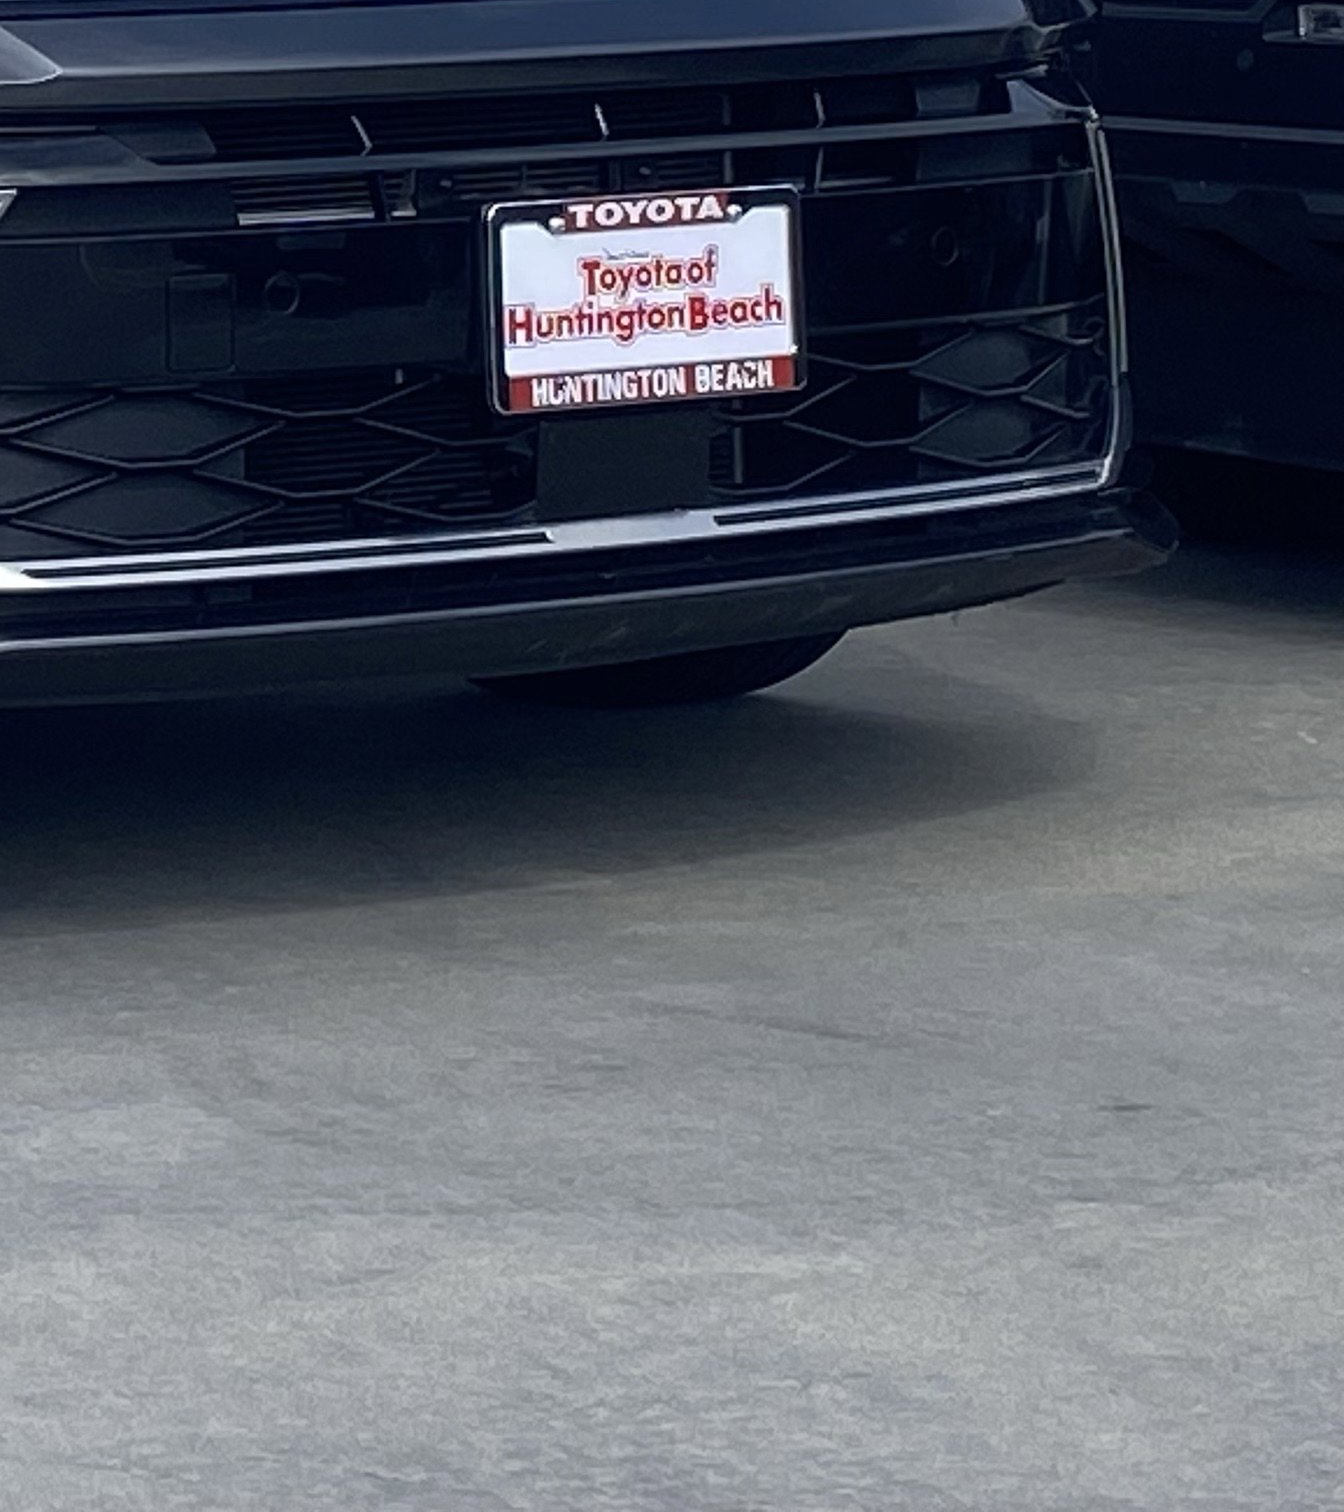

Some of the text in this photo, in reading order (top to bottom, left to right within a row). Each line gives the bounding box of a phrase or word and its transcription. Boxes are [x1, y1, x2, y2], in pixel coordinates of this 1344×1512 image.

[568, 195, 725, 229] TOYOTA
[580, 247, 717, 297] Toyota of
[506, 286, 784, 345] Huntington Beach
[531, 359, 775, 408] HUNTINGTON BEACH
